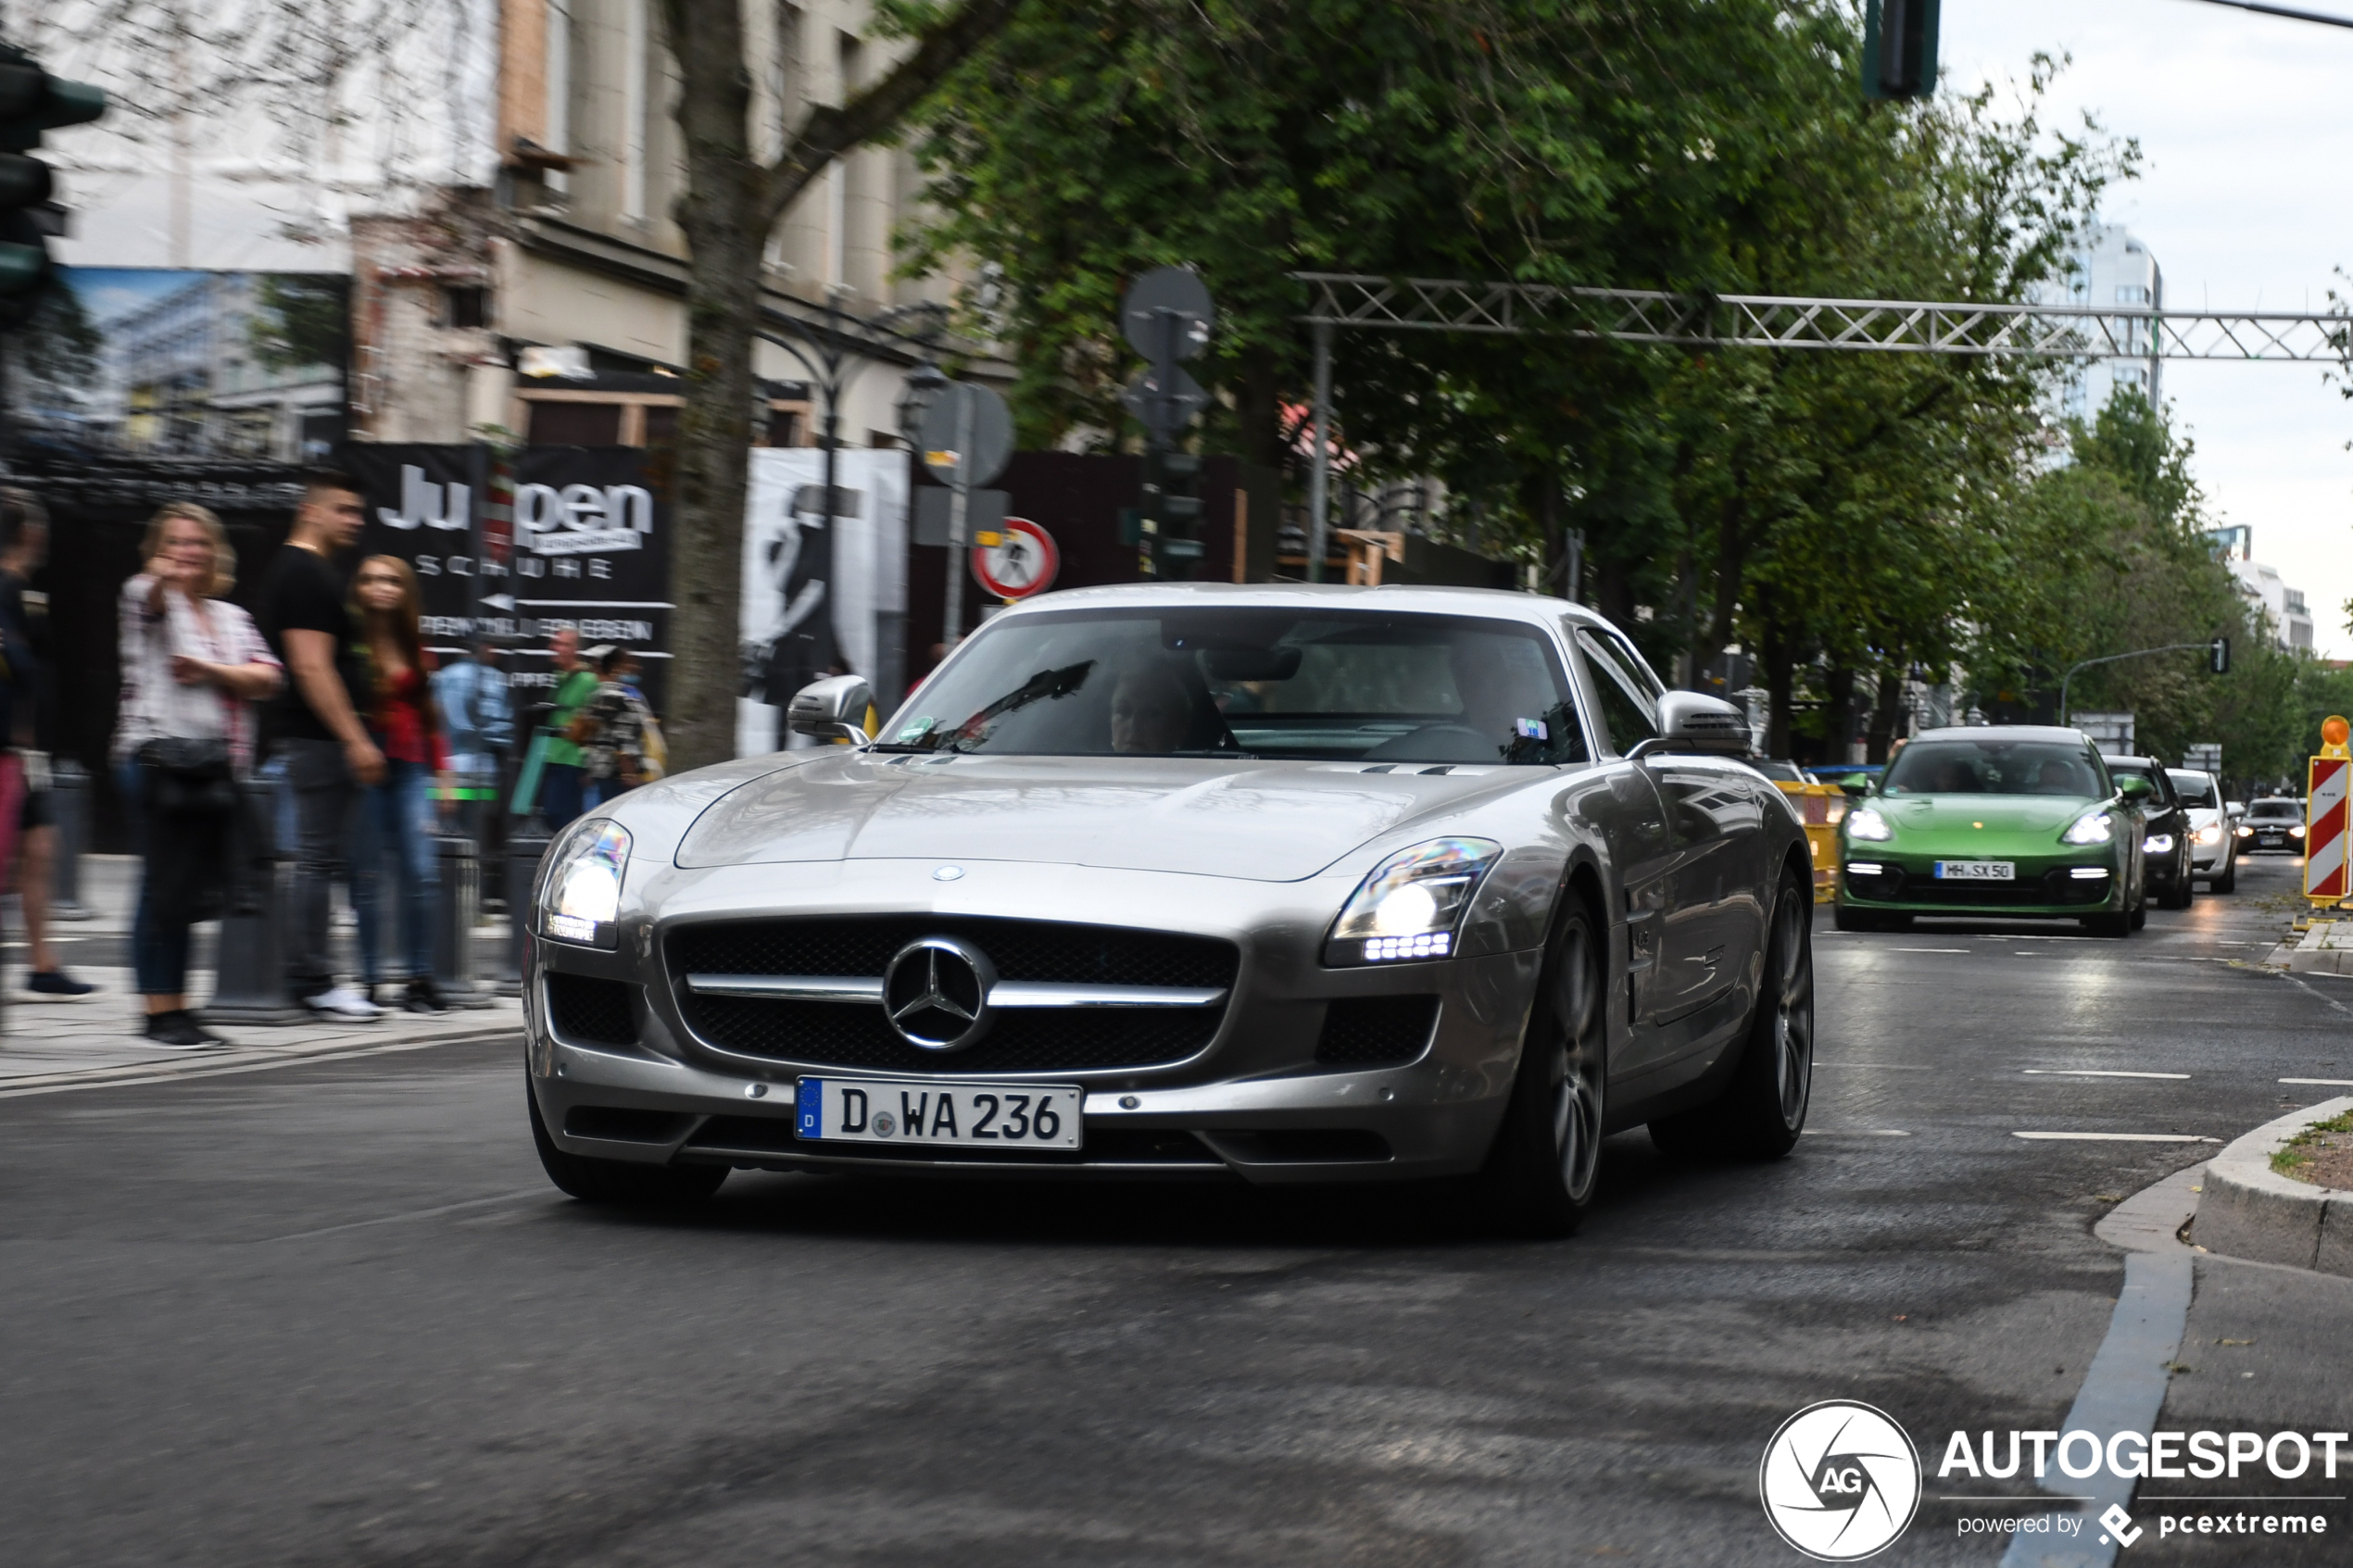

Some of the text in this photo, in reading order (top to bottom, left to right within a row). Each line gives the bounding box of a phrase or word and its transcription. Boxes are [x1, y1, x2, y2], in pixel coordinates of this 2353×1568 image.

[376, 464, 653, 548] Jupen
[1991, 865, 2009, 878] 50
[804, 1114, 814, 1127] D
[840, 1087, 1060, 1140] D WA 236
